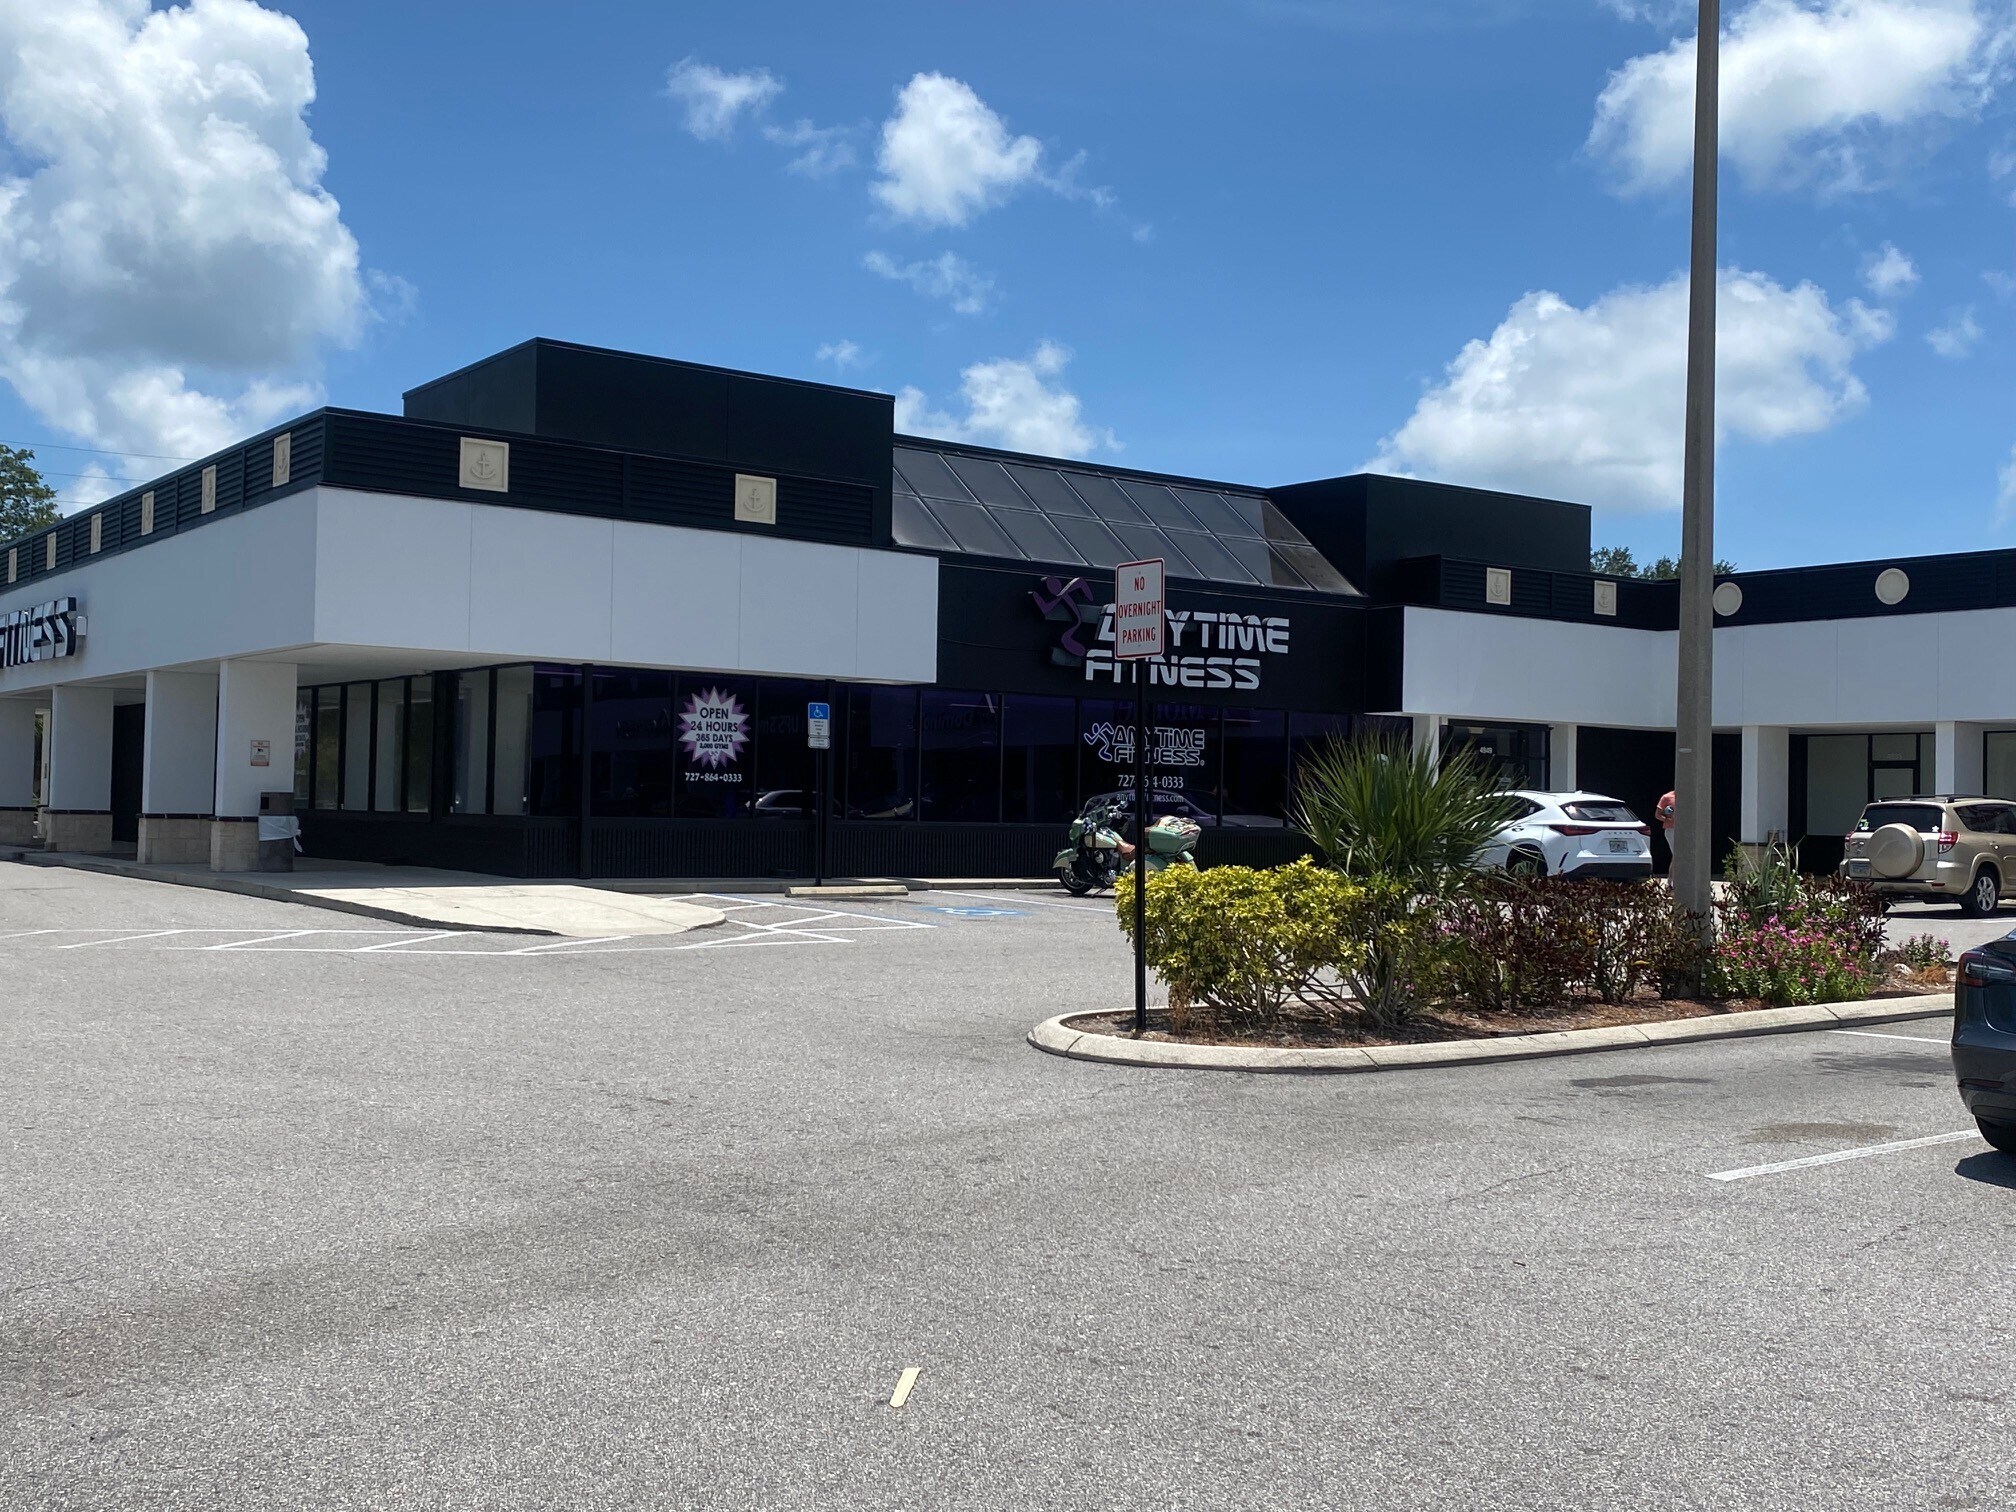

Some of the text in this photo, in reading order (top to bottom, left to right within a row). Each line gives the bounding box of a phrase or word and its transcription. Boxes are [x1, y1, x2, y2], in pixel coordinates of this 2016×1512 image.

[1134, 576, 1145, 591] NO
[1118, 600, 1161, 618] OVERNIGHT
[1122, 627, 1156, 644] PARKING
[700, 707, 729, 719] OPEN
[691, 721, 738, 732] 24 HOURS
[696, 733, 733, 743] 365 DAYS
[685, 772, 742, 782] 727-864-0333
